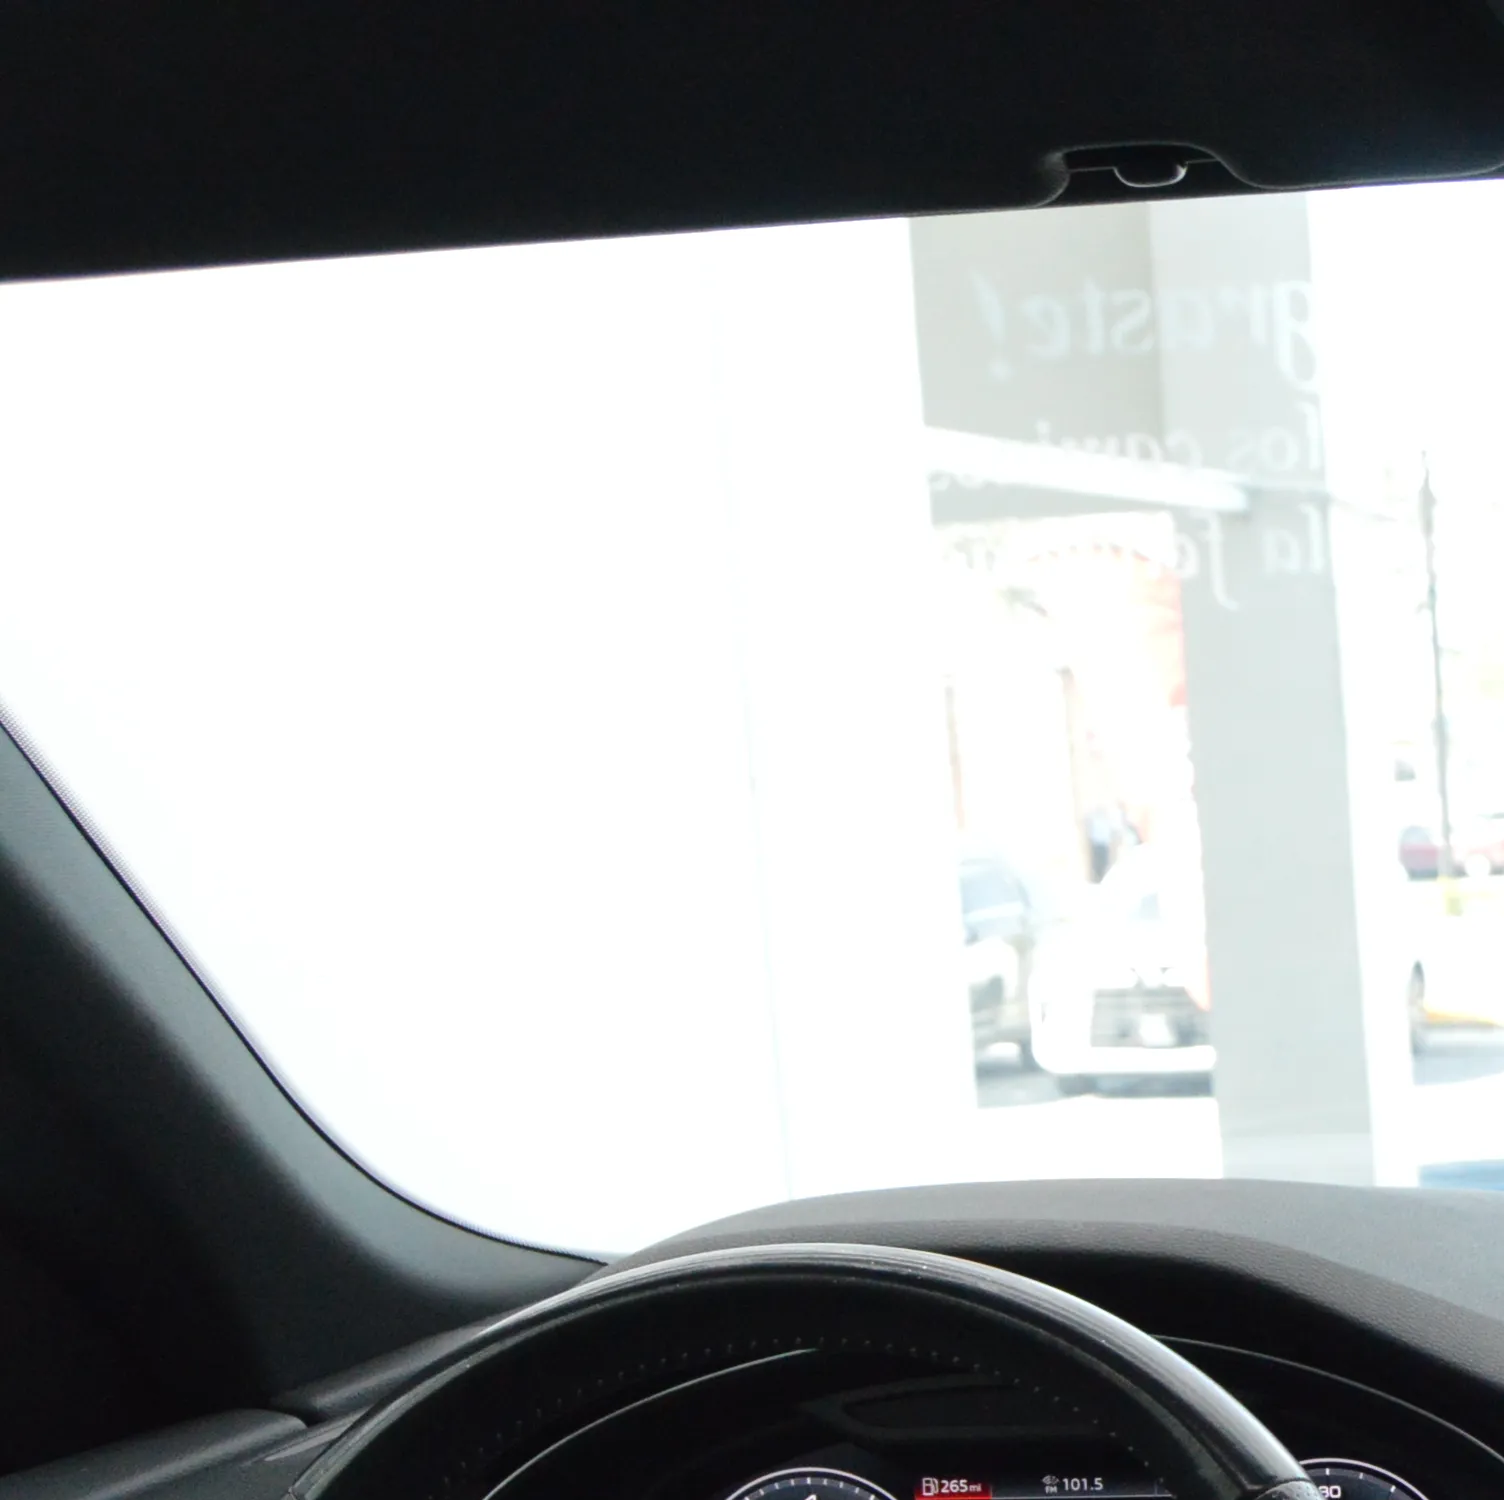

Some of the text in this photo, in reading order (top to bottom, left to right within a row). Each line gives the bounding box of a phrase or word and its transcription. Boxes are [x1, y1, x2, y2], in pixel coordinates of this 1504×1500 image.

[940, 1479, 982, 1494] 265 mi
[1063, 1478, 1103, 1491] 101.5
